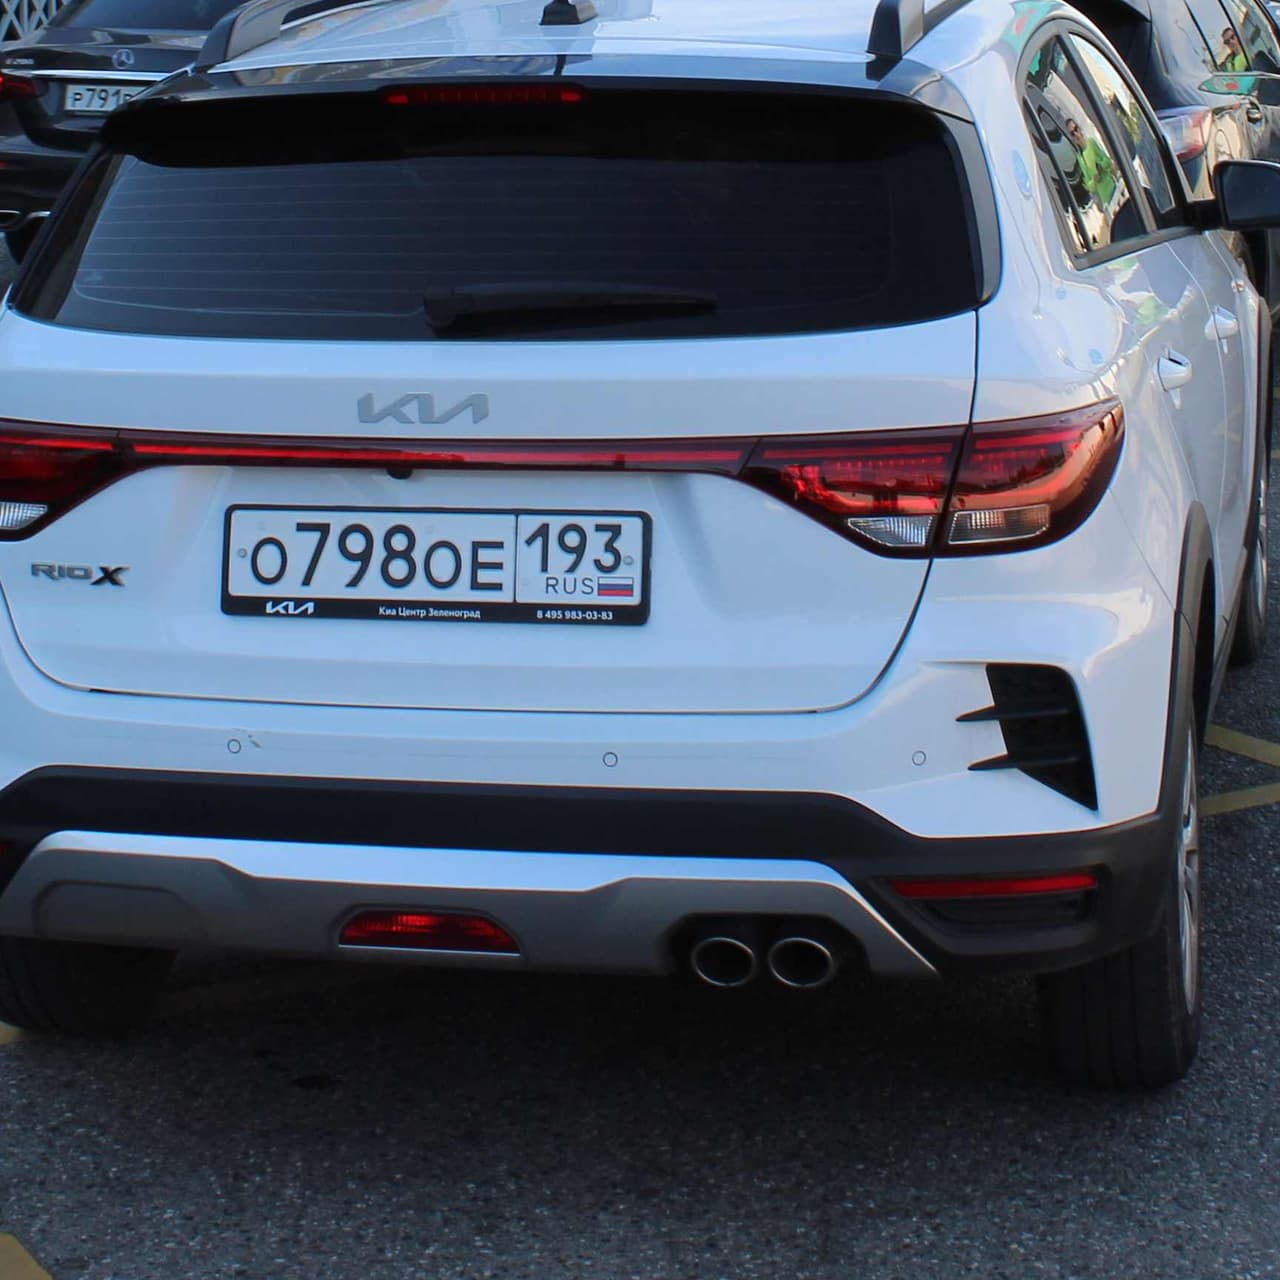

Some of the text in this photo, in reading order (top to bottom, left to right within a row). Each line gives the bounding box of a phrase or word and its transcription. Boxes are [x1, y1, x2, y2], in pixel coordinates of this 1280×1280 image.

[524, 522, 623, 574] 193
[544, 576, 595, 596] RUS
[378, 606, 481, 620] Киа Центр Зеленоград
[536, 610, 614, 621] 8 495 983-03-83
